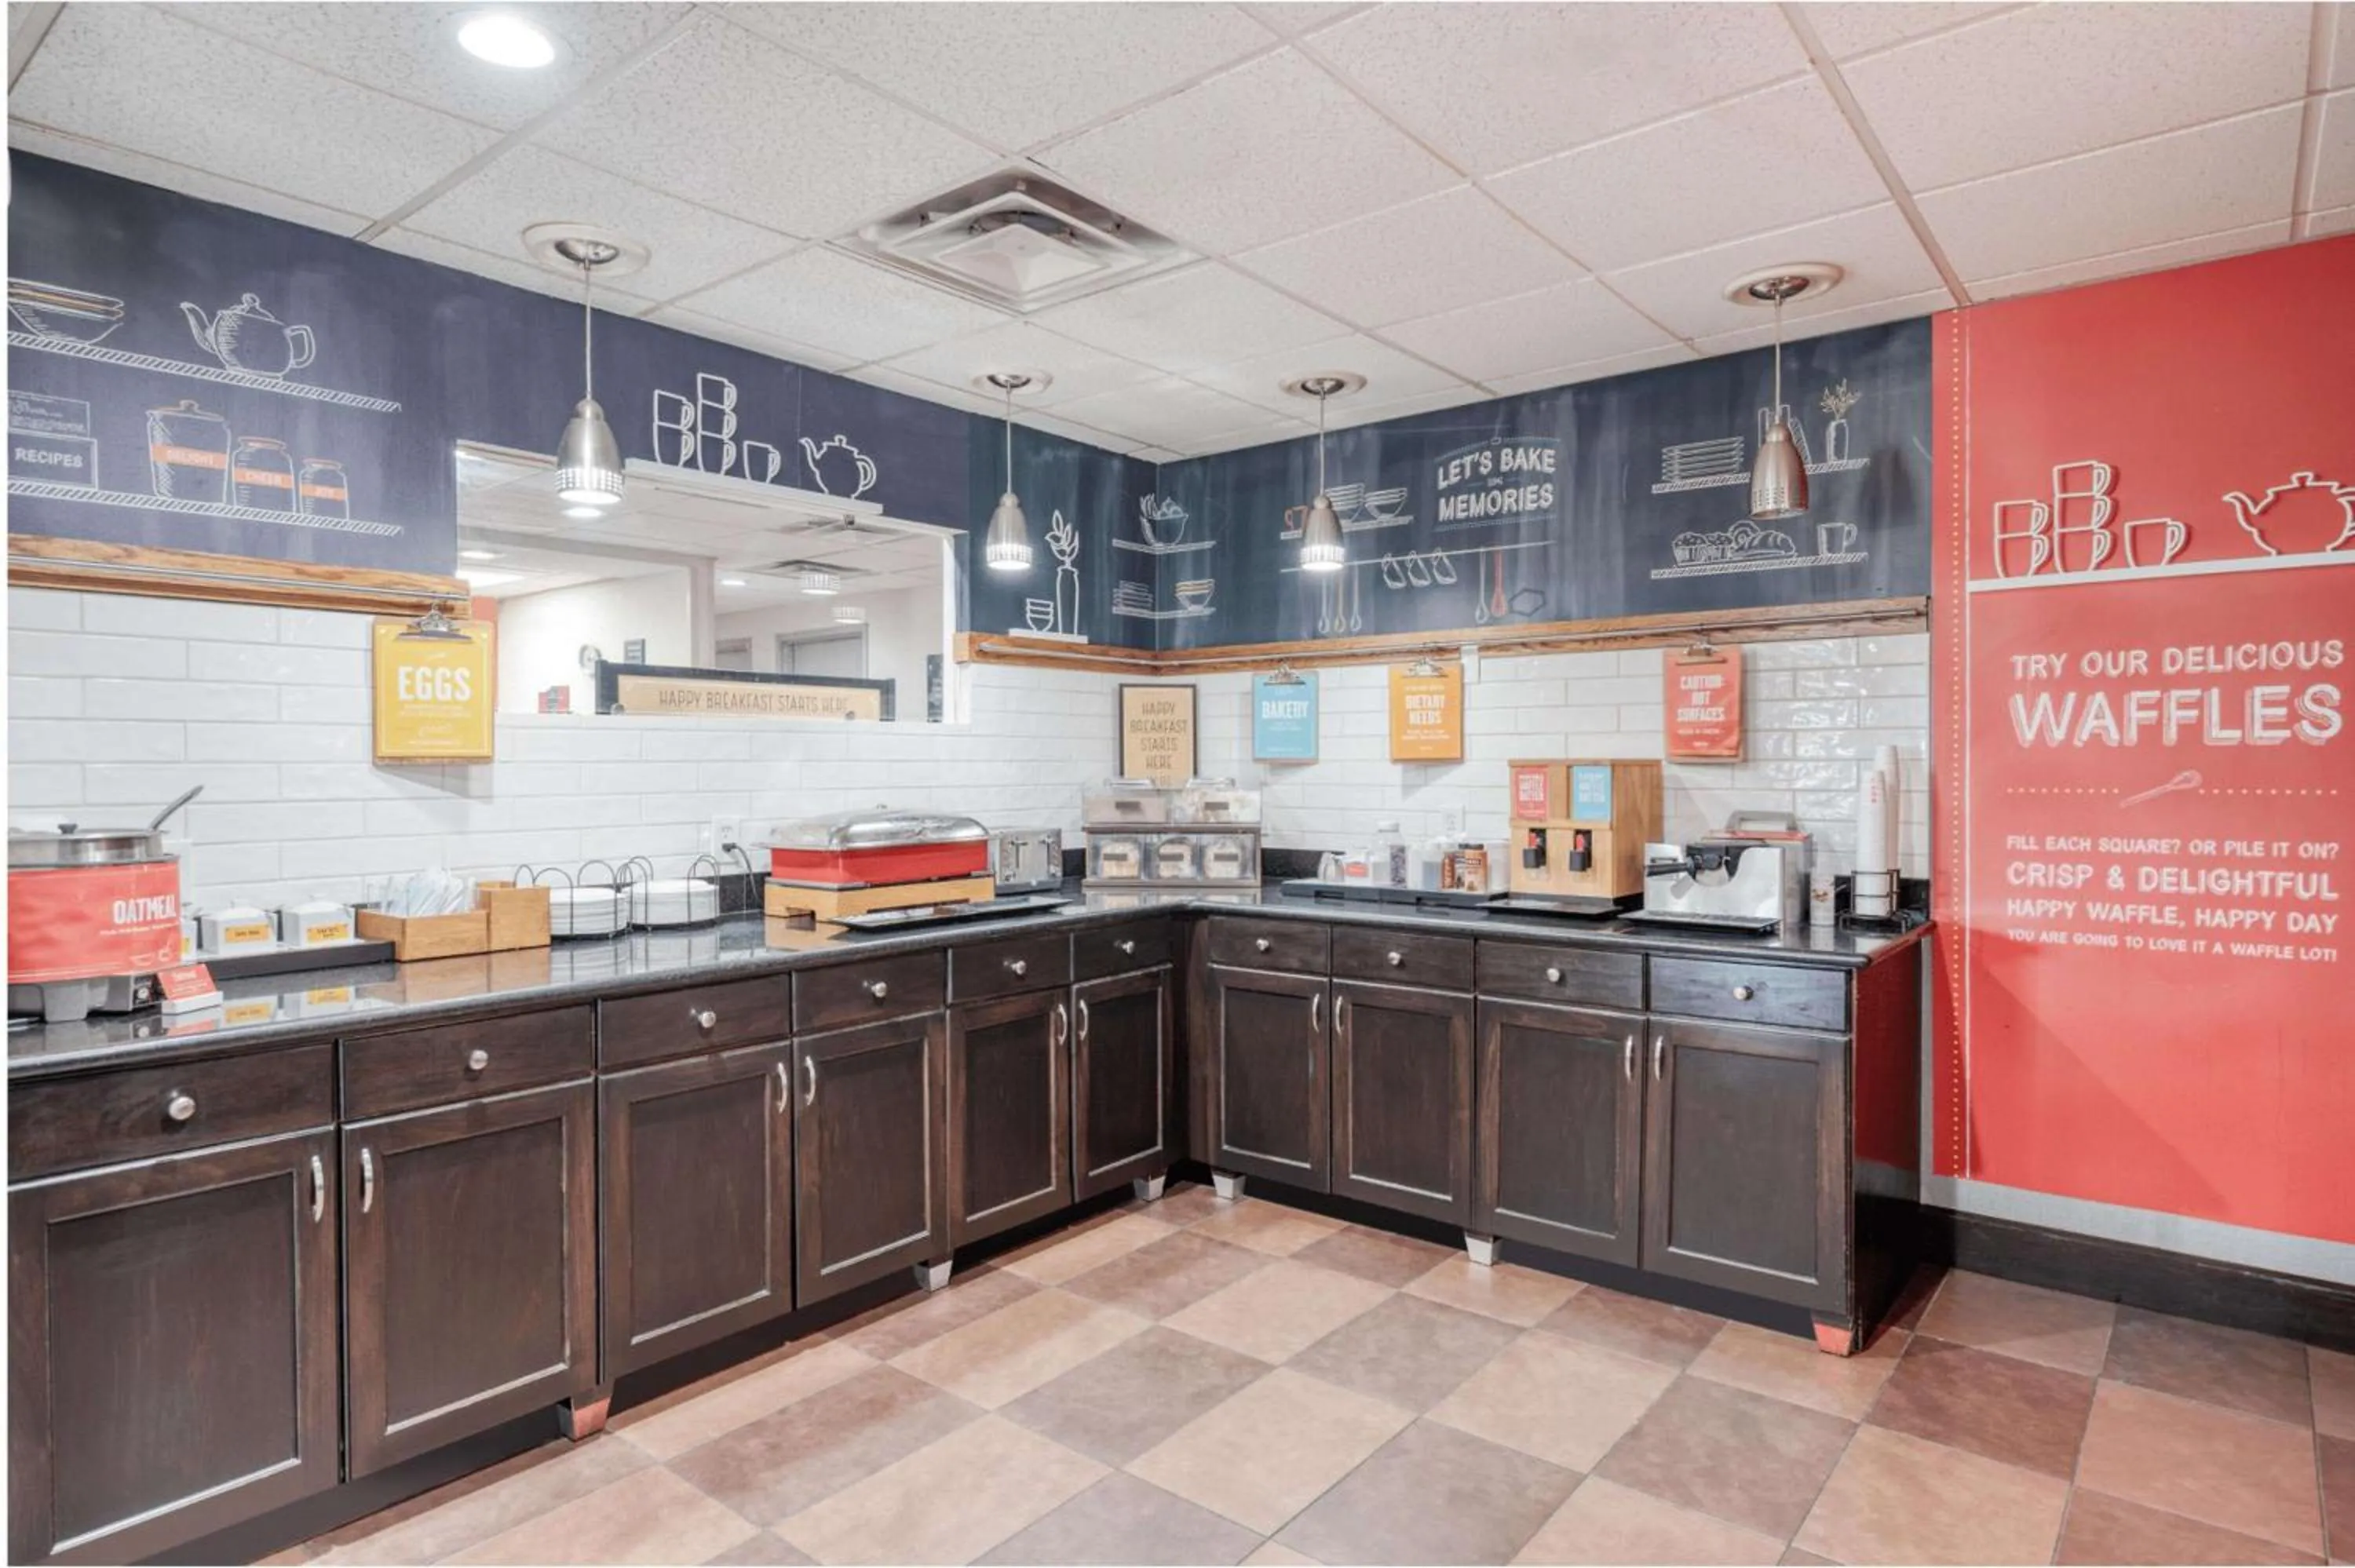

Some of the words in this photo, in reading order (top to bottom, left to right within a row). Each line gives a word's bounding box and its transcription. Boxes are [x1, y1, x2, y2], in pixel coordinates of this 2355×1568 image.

[14, 447, 84, 468] RECIPES
[1437, 450, 1492, 490] LET'S
[1499, 447, 1557, 474] BAKE
[1438, 483, 1555, 522] MEMORIES
[2010, 653, 2067, 680] TRY
[2082, 651, 2148, 678] OUR
[2162, 640, 2344, 675] DELICIOUS
[397, 665, 473, 701] EGGS
[659, 690, 702, 709] HAPPY
[706, 691, 772, 712] BREAKFAST
[778, 695, 818, 713] STARTS
[1141, 702, 1175, 716] HAPPY
[1261, 700, 1309, 719] BAKERY
[2009, 683, 2342, 748] WAFFLES
[1129, 719, 1188, 734] BREAKFAST
[1140, 738, 1178, 752] STARTS
[1146, 754, 1174, 770] HERE
[2006, 835, 2039, 851] FILL
[2046, 837, 2091, 851] EACH
[2098, 837, 2181, 854] SQUARE?
[2189, 840, 2217, 855] OR
[2224, 841, 2265, 856] PILE
[2273, 842, 2291, 857] IT
[2298, 843, 2339, 860] ON?
[2006, 862, 2094, 888] CRISP
[2106, 866, 2125, 891] &
[2138, 866, 2339, 900] DELIGHTFUL
[113, 895, 177, 924] OATMEAL
[2006, 899, 2077, 920] HAPPY
[2086, 902, 2185, 928] WAFFLE,
[2195, 907, 2276, 931] HAPPY
[2286, 912, 2339, 934] DAY
[2007, 929, 2035, 942] YOU
[2039, 931, 2068, 943] ARE
[2072, 933, 2118, 947] GOING
[2123, 935, 2144, 949] TO
[2149, 938, 2187, 952] LOVE
[2193, 940, 2207, 954] IT
[2212, 942, 2224, 954] A
[2229, 943, 2294, 959] WAFFLE
[2299, 947, 2338, 962] LOT!
